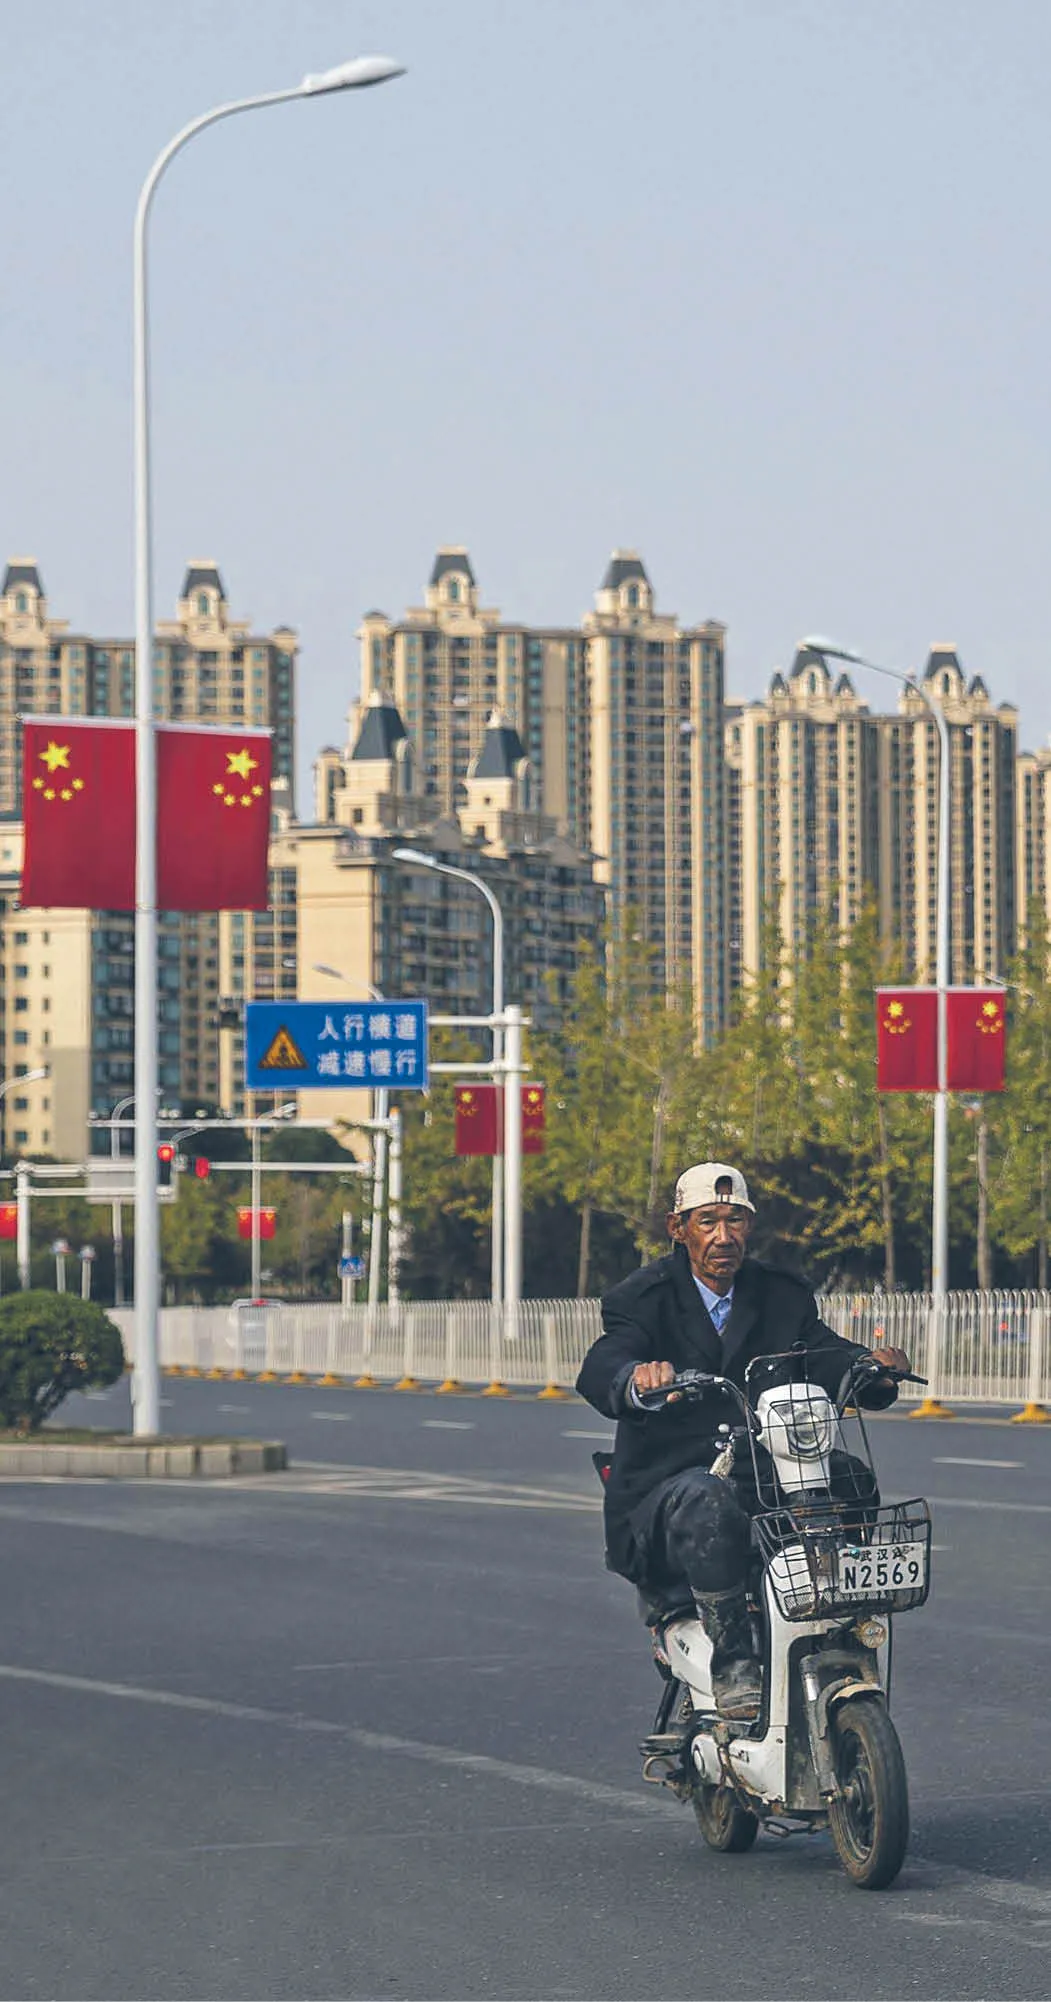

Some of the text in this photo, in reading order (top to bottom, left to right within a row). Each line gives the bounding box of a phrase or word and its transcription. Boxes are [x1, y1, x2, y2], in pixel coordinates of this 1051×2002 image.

[317, 1014, 417, 1041] 人行横道
[317, 1049, 417, 1077] 减速慢行
[844, 1561, 919, 1590] N2569
